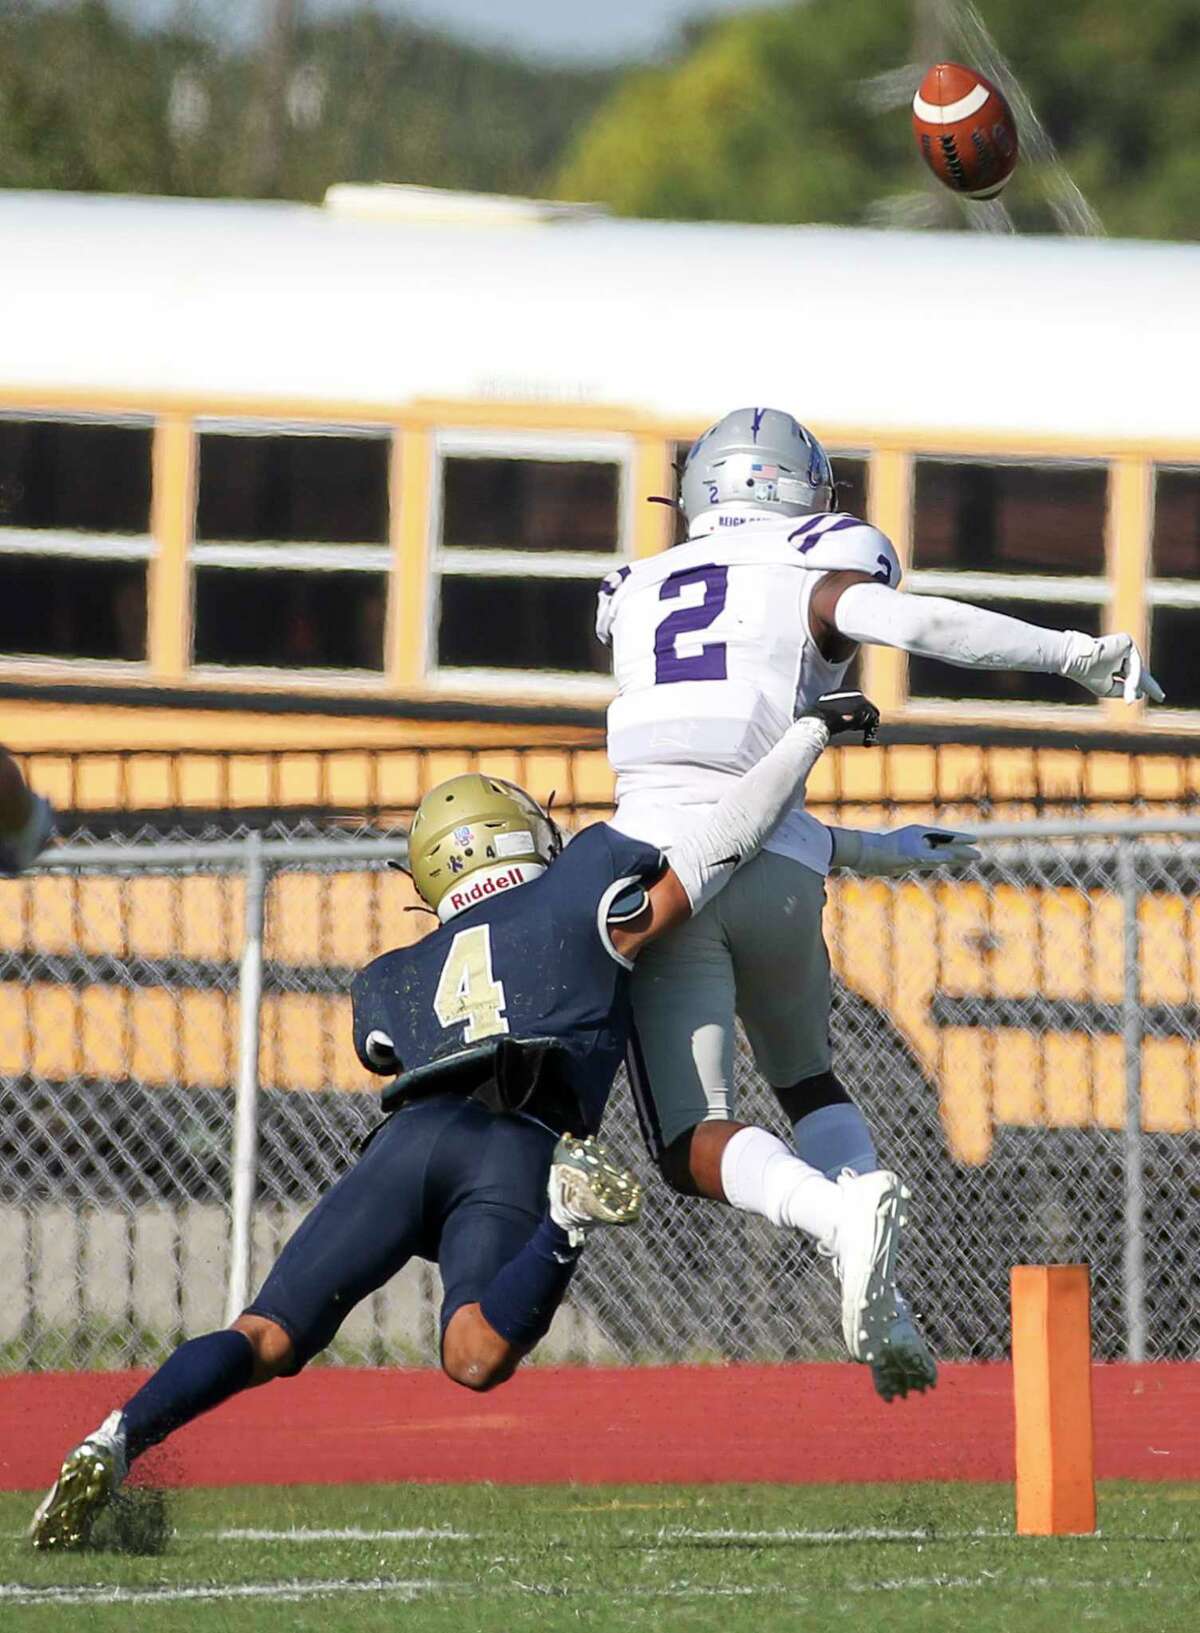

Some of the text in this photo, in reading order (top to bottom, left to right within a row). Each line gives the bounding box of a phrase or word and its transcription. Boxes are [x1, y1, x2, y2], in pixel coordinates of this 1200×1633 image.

[654, 563, 728, 684] 2
[450, 868, 525, 910] Riddell
[434, 923, 509, 1043] 4
